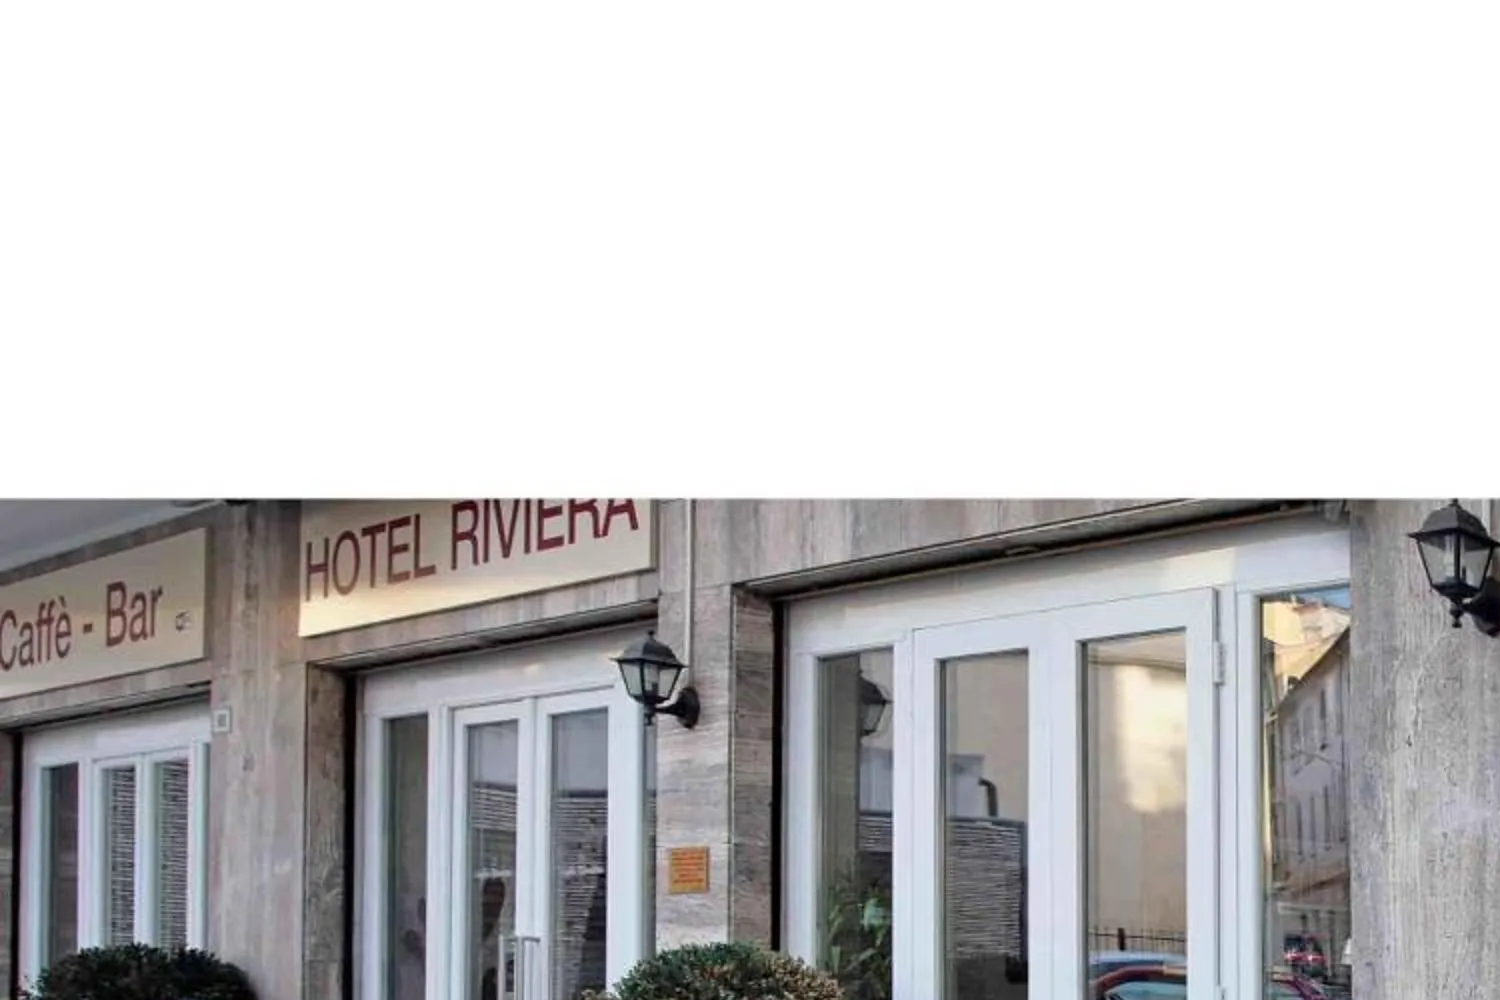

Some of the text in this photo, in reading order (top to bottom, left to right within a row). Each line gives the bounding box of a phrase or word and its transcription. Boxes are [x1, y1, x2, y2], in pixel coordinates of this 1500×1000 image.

[306, 498, 639, 602] HOTEL RIVIERA
[0, 596, 72, 671] Caffè
[106, 581, 163, 647] Bar
